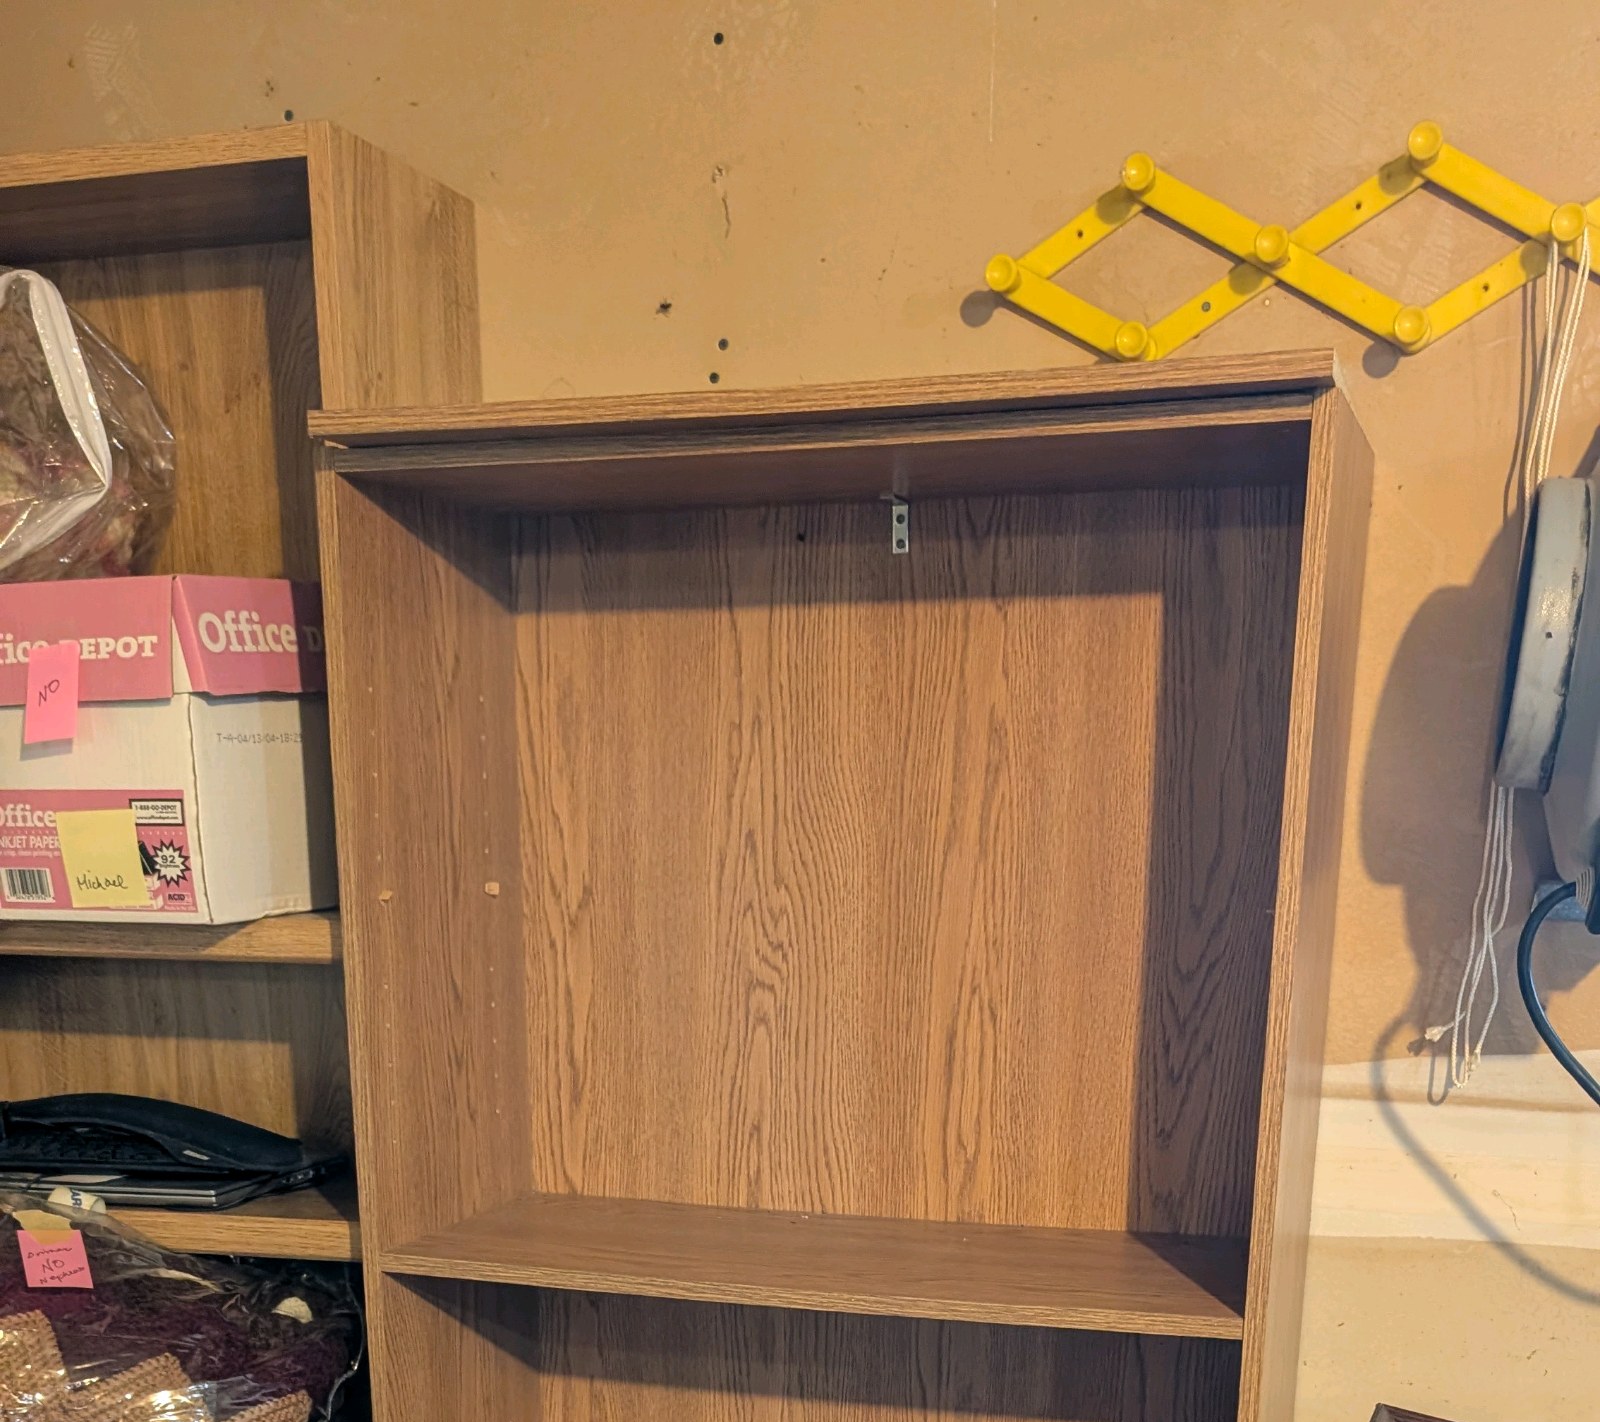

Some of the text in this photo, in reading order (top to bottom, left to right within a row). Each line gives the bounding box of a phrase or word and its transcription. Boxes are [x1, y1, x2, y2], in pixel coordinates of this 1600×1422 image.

[197, 610, 298, 653] Office
[59, 635, 158, 660] EPOT
[38, 679, 60, 707] NO
[161, 855, 176, 864] 92
[76, 870, 128, 890] Michael
[41, 1258, 65, 1274] NO
